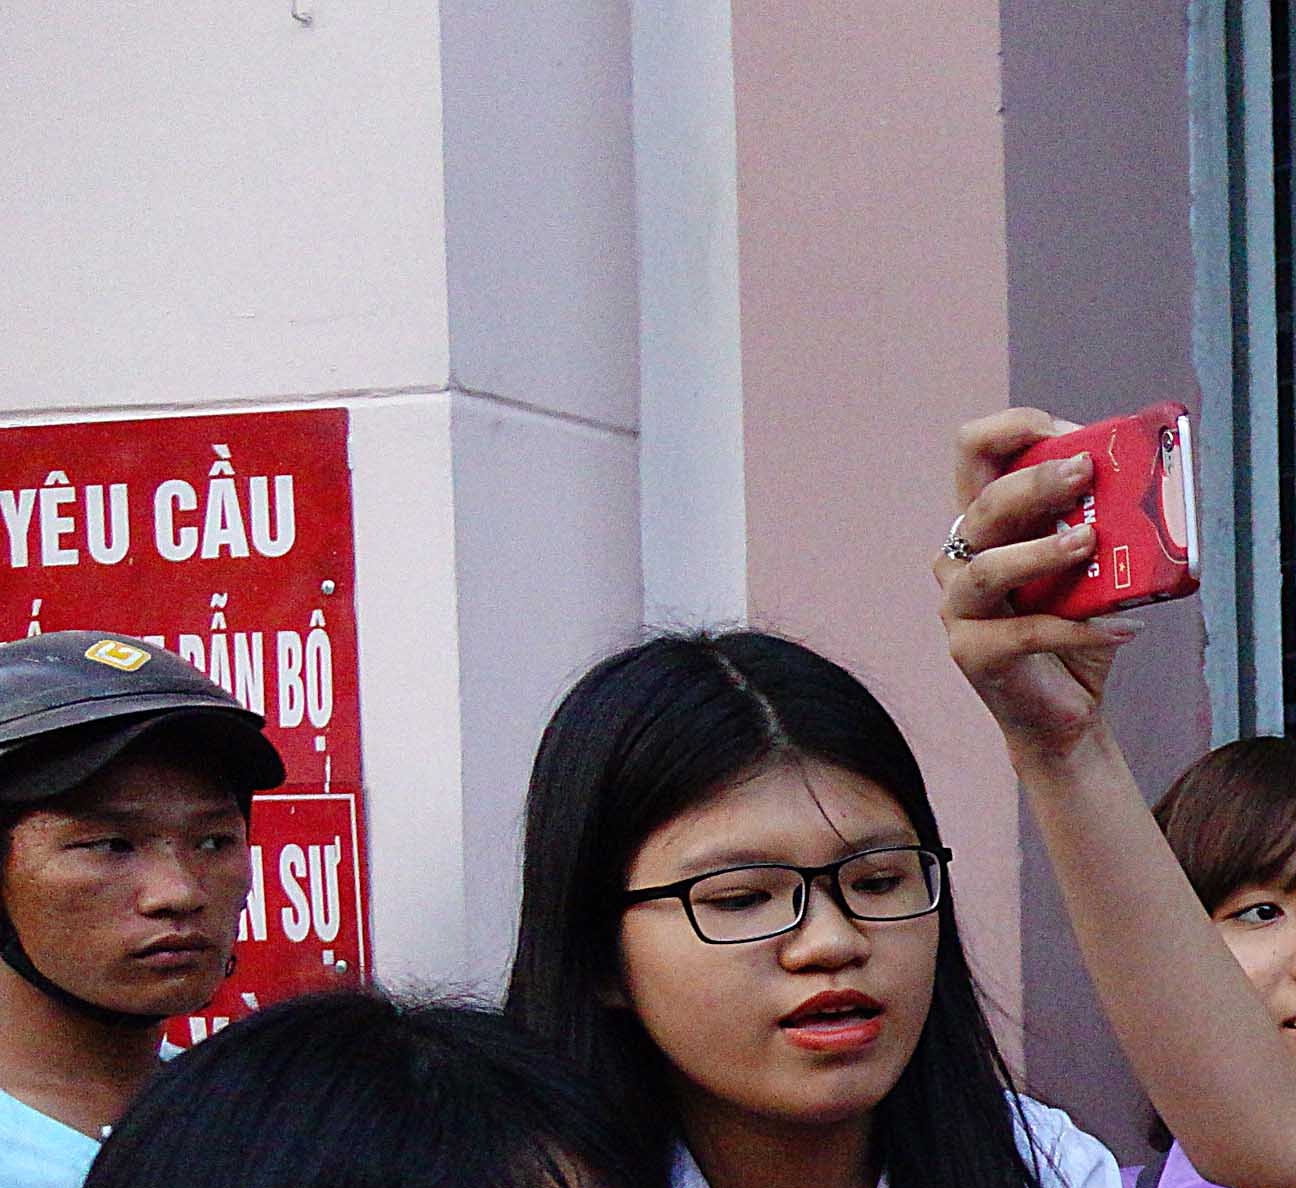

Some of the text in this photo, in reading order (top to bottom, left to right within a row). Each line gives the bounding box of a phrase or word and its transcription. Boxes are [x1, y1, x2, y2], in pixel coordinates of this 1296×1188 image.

[1, 444, 297, 568] YÊU CẦU
[278, 609, 333, 752] BỘ
[281, 835, 341, 966] SỰ
